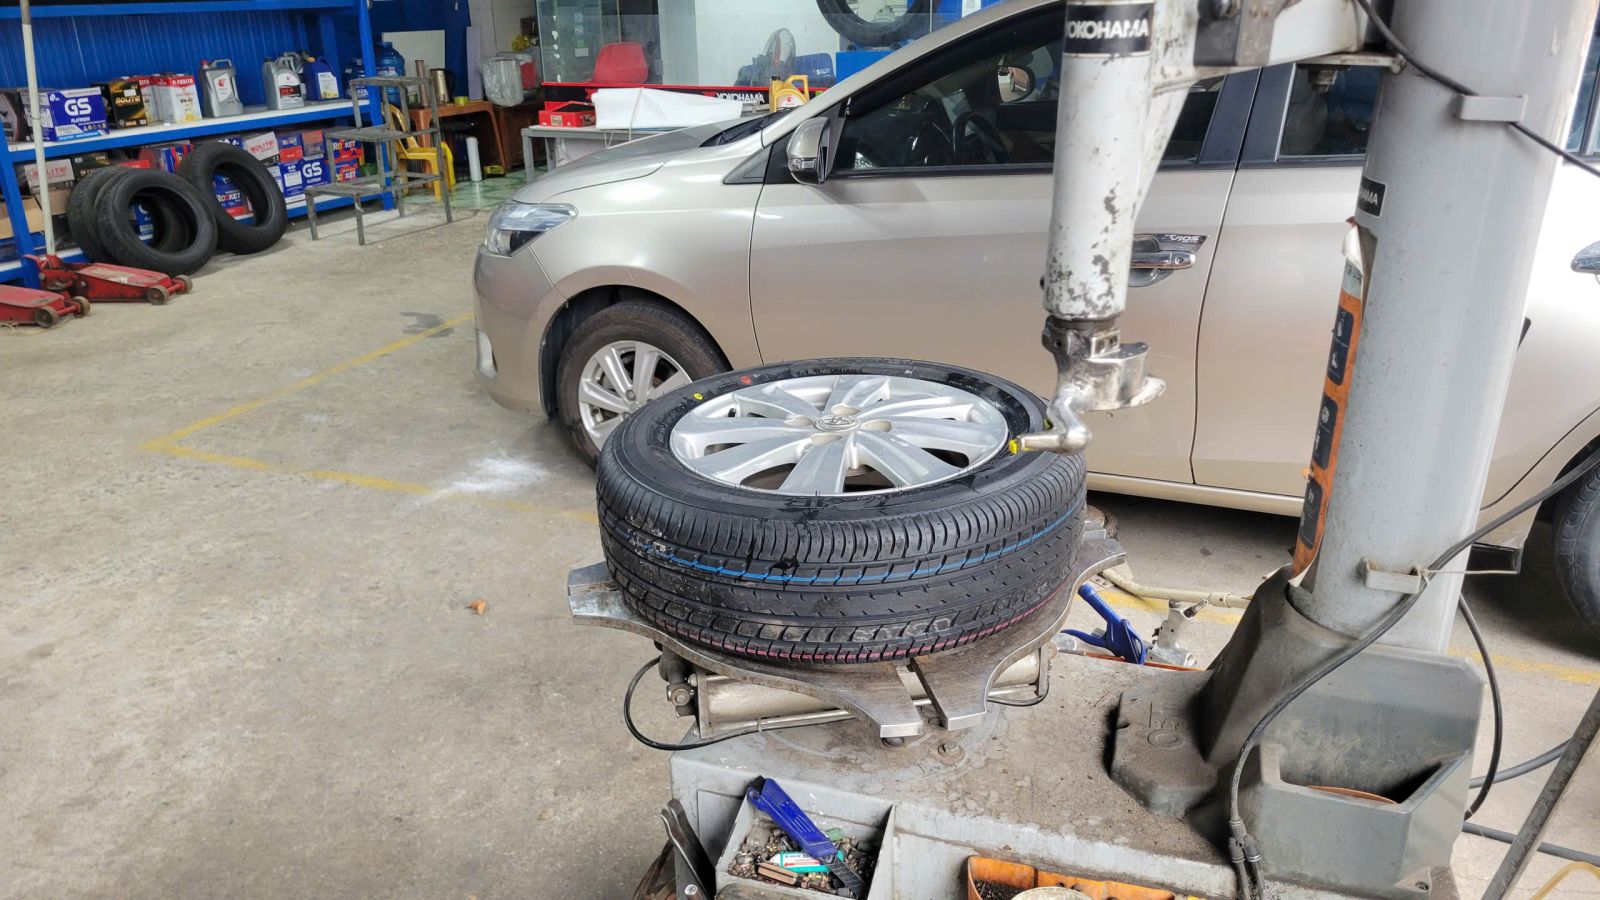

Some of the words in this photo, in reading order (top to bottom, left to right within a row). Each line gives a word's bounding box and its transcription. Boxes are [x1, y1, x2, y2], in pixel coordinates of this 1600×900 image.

[1067, 18, 1149, 39] OKOHAMA
[716, 93, 765, 103] YOKOHAMA
[64, 98, 92, 116] GS
[302, 161, 323, 178] GS
